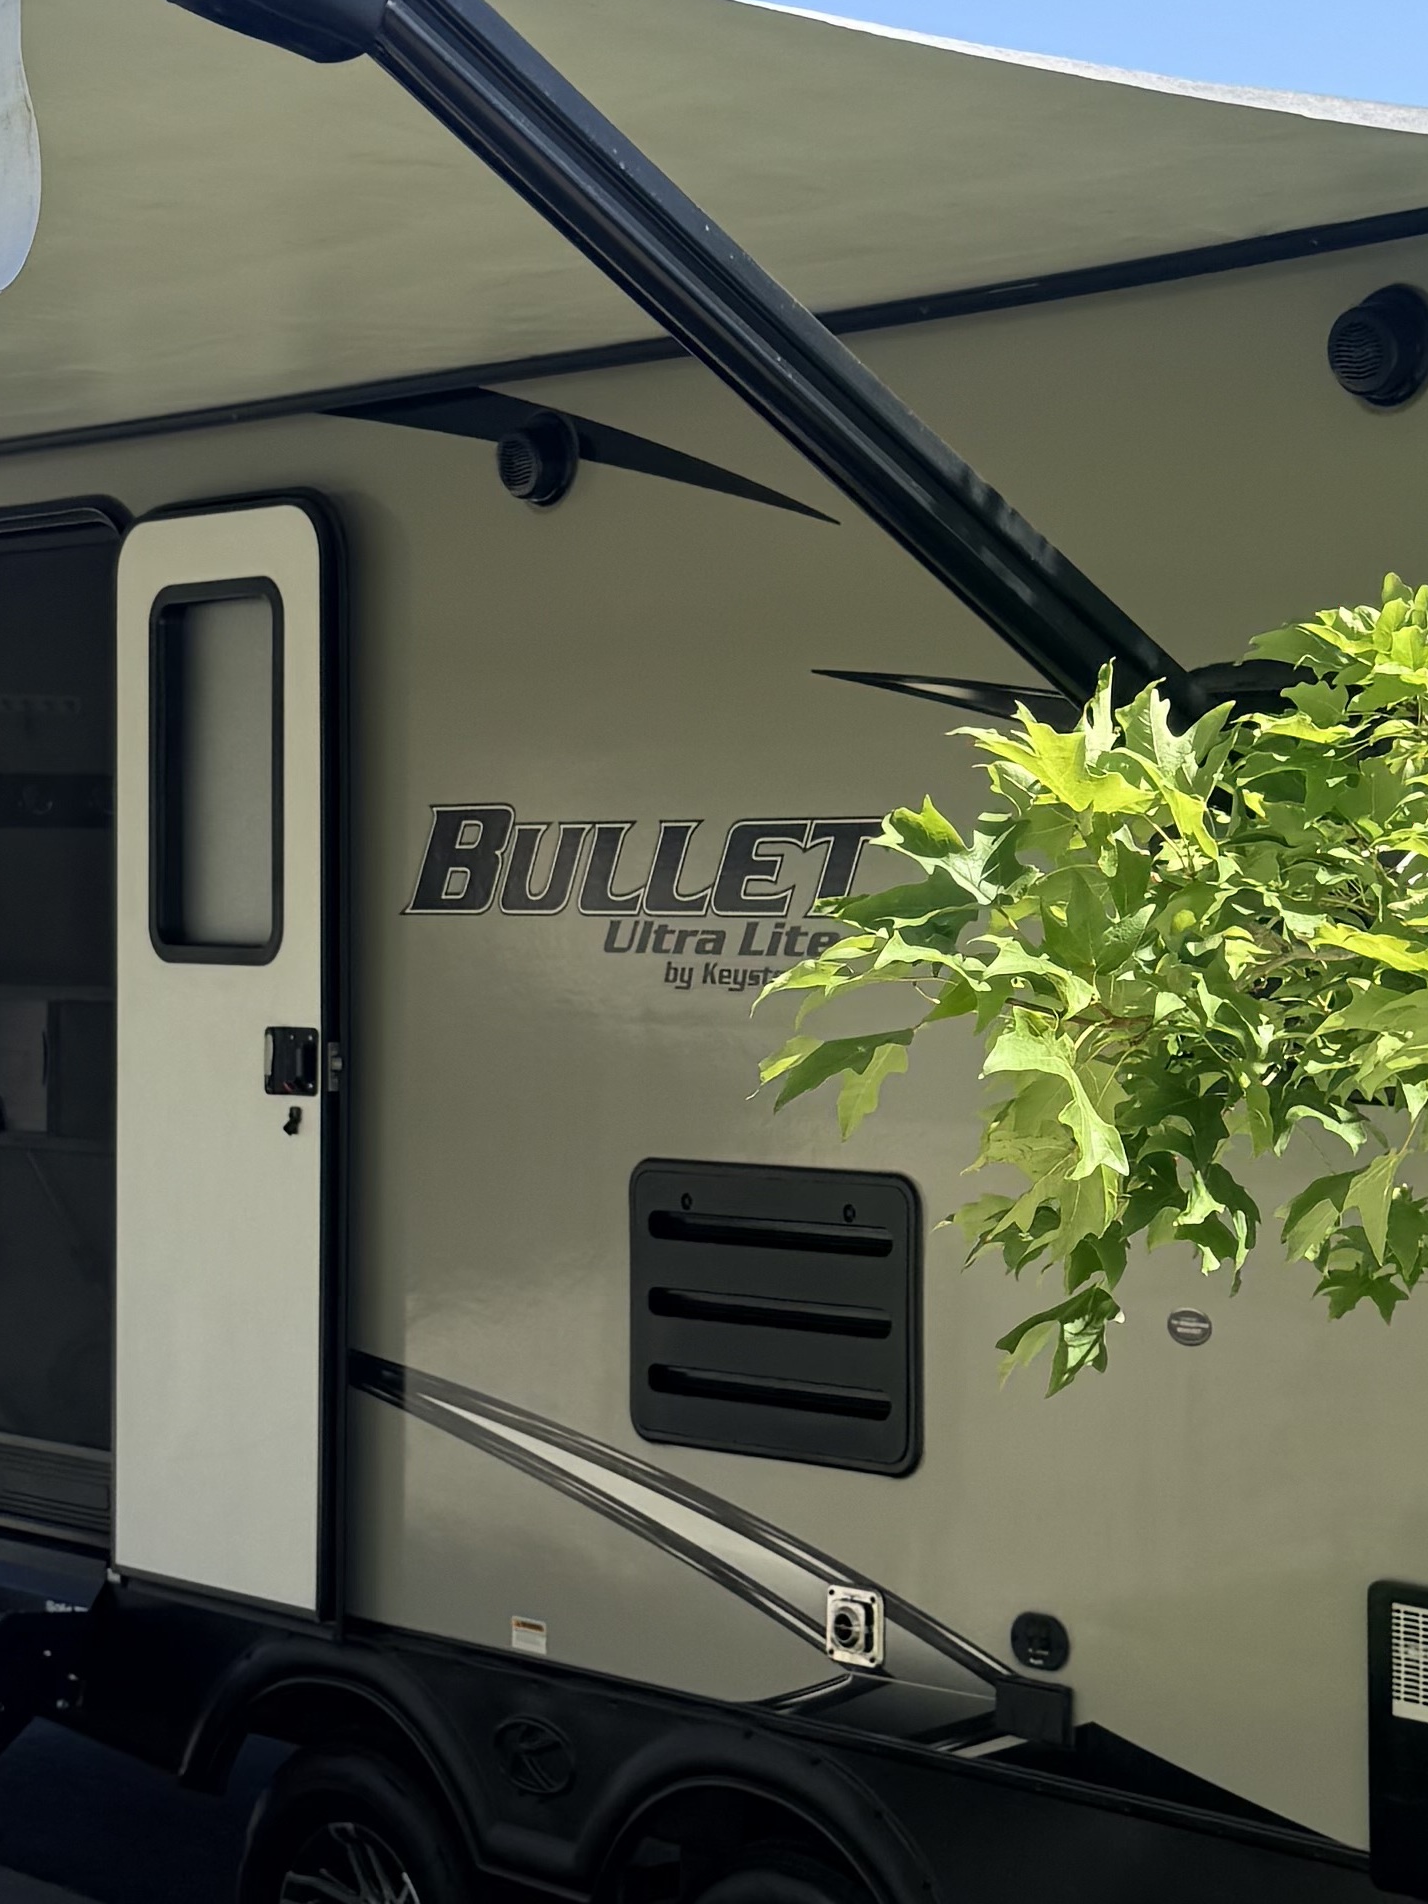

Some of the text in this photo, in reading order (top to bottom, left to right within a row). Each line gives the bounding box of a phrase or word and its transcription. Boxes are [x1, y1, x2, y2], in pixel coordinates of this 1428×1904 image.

[400, 803, 884, 918] BULLET
[603, 920, 841, 957] Ultra Lite
[664, 962, 784, 992] by Keyst
